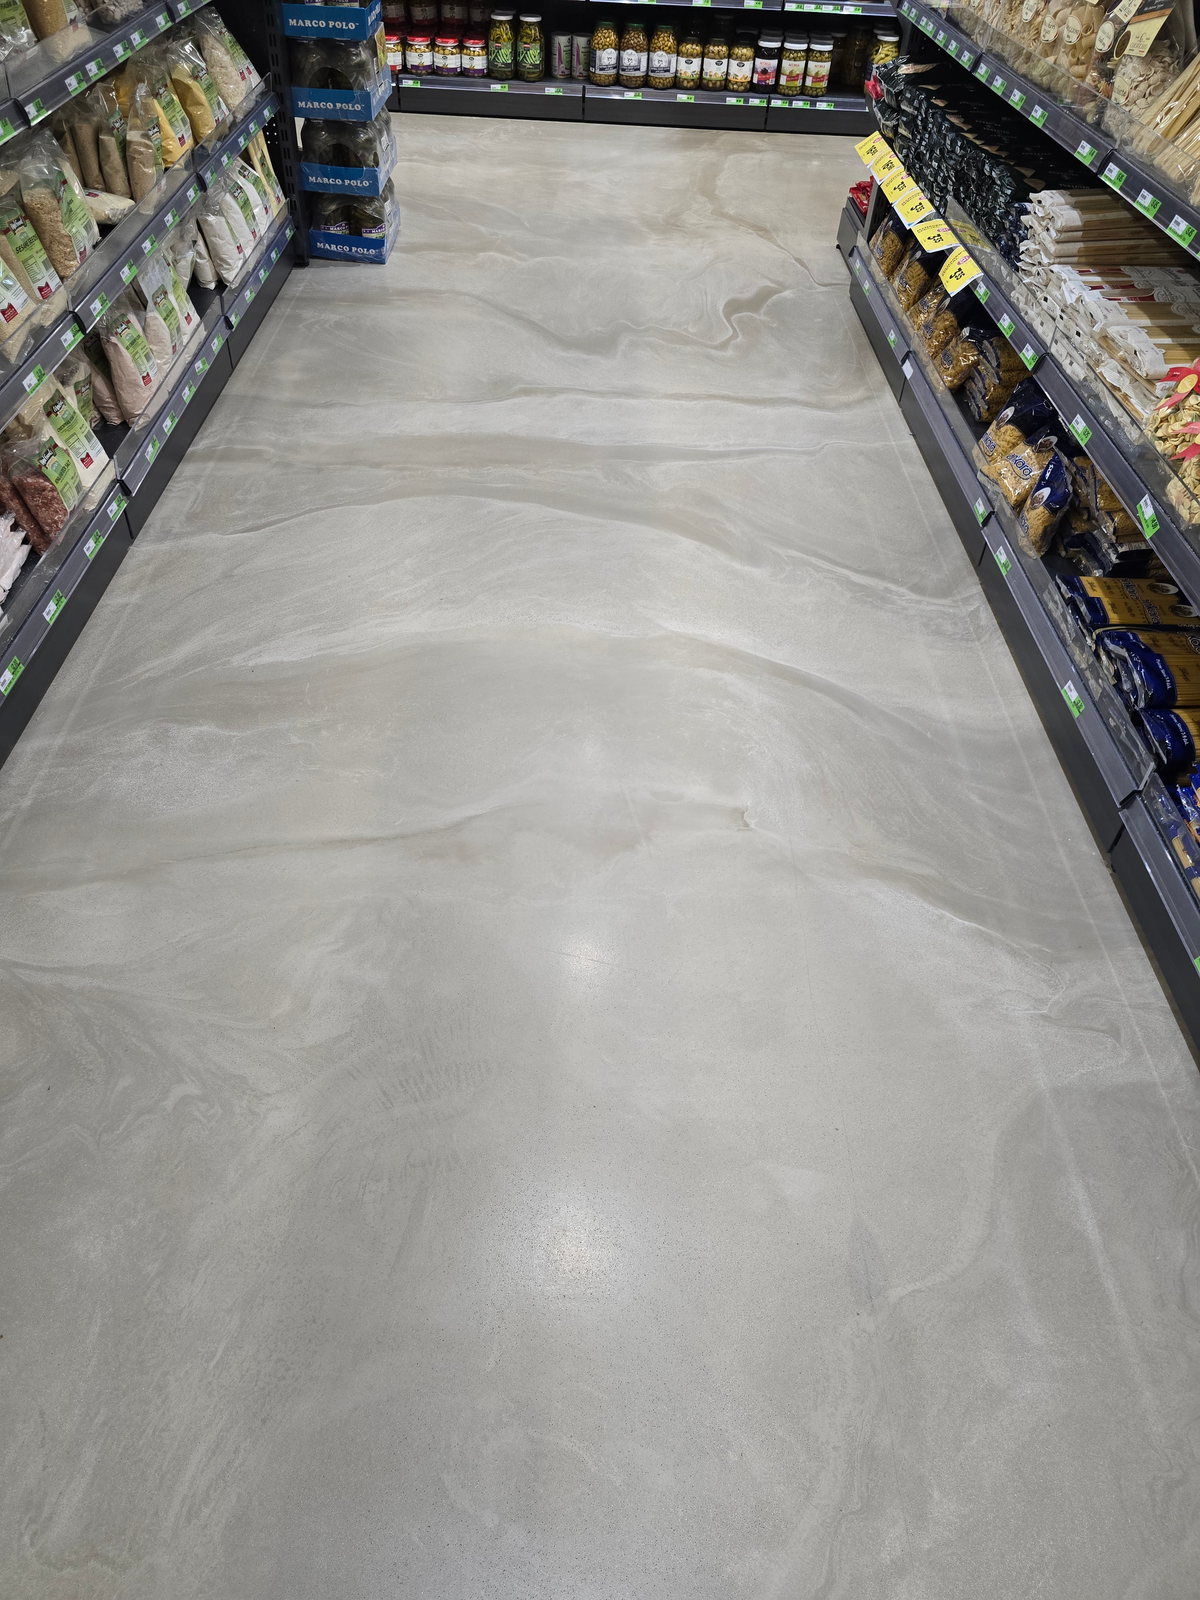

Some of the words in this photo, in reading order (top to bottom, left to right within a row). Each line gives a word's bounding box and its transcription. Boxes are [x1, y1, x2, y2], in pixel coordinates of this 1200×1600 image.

[288, 18, 326, 27] MARCO
[328, 20, 356, 29] POLO
[298, 101, 333, 109] MARCO
[336, 102, 361, 111] POLO
[308, 176, 342, 184] MARCO
[316, 242, 349, 251] MARCO
[352, 246, 375, 254] POLO
